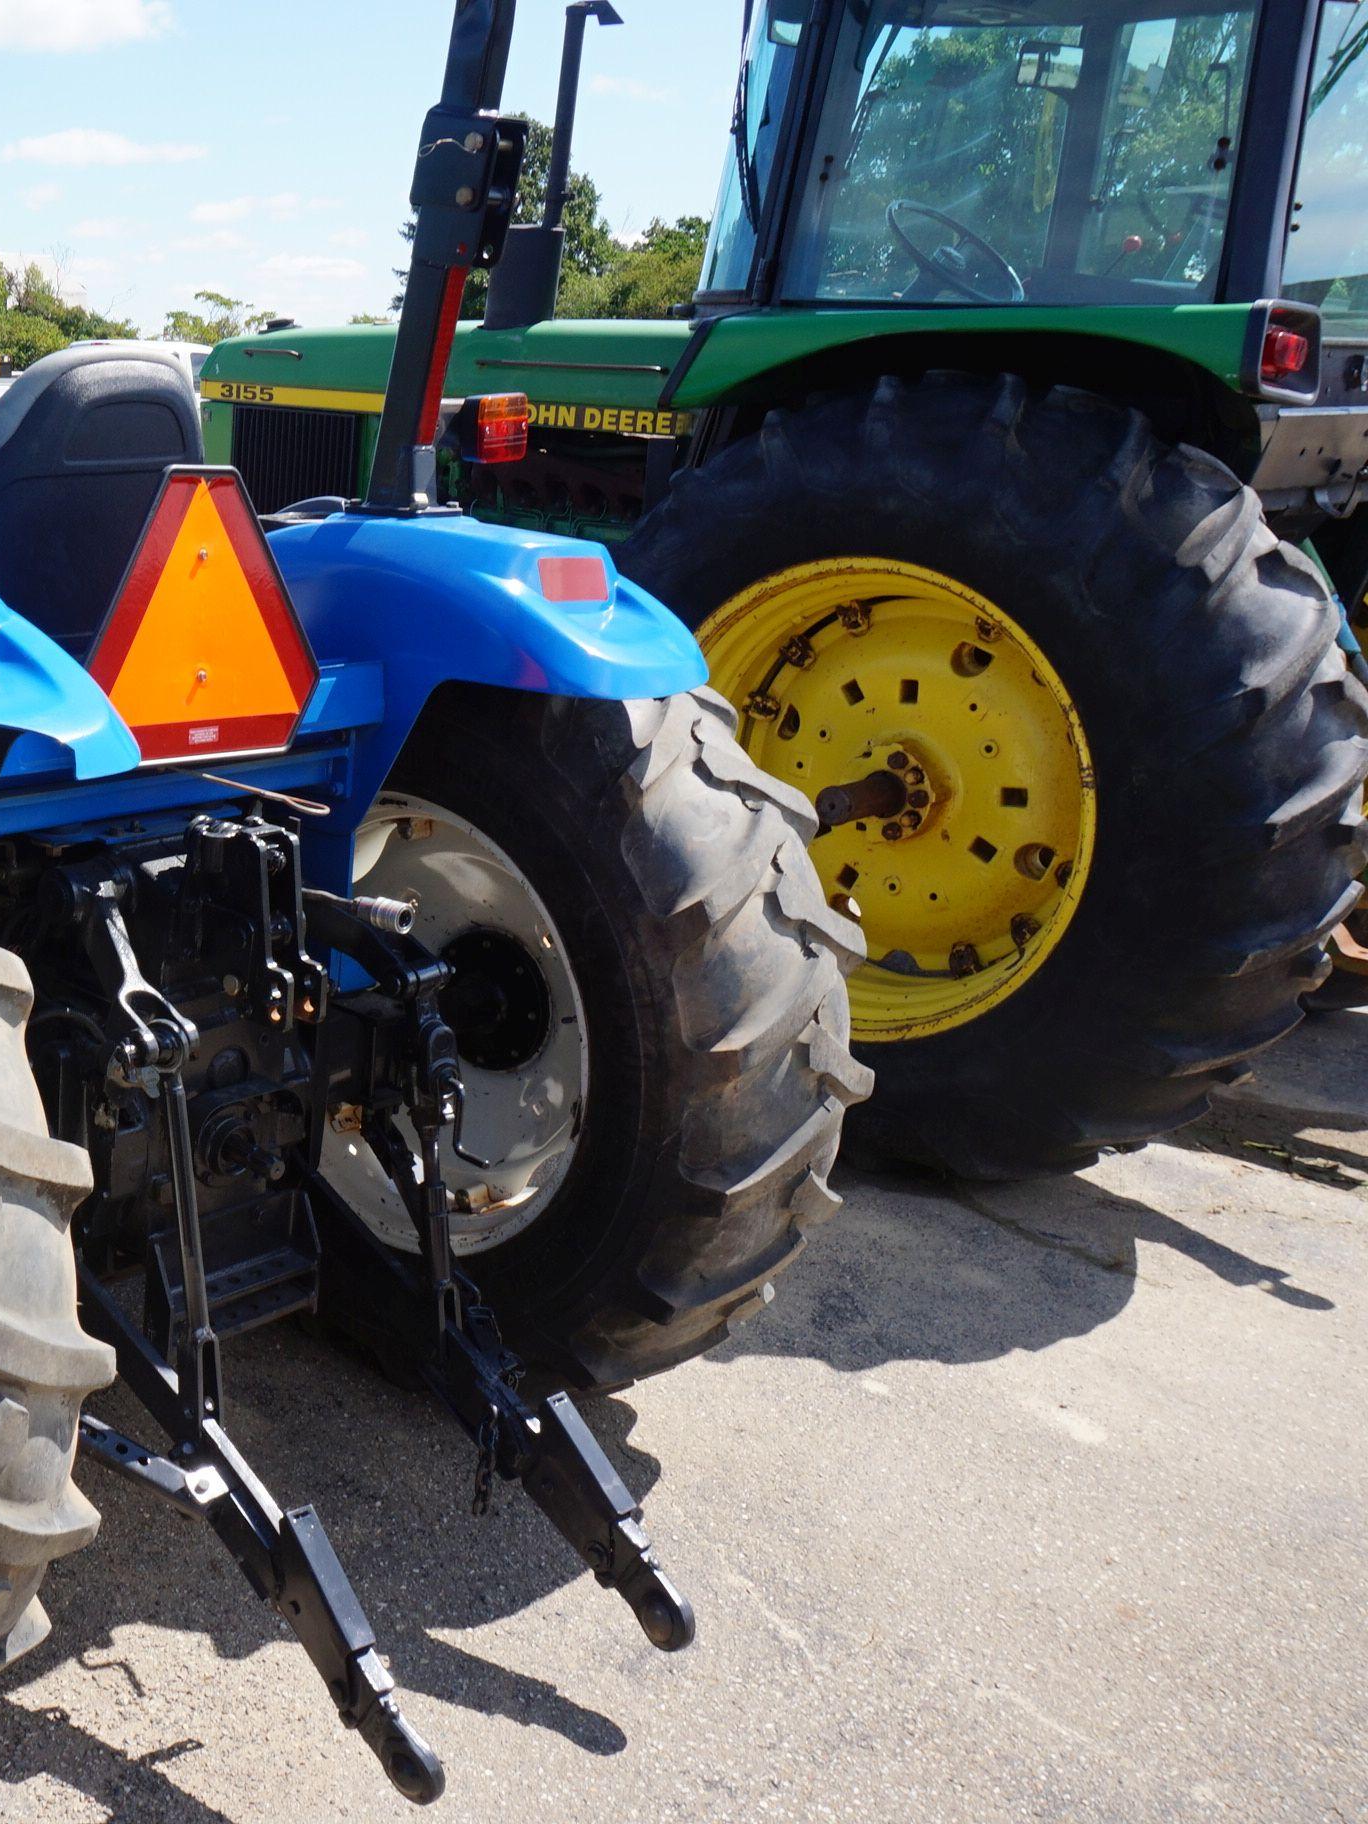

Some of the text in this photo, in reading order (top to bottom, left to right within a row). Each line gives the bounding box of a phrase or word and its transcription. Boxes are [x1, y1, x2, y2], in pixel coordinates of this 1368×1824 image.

[220, 384, 274, 402] 3155
[525, 403, 576, 427] OHN
[583, 407, 672, 434] DEERE
